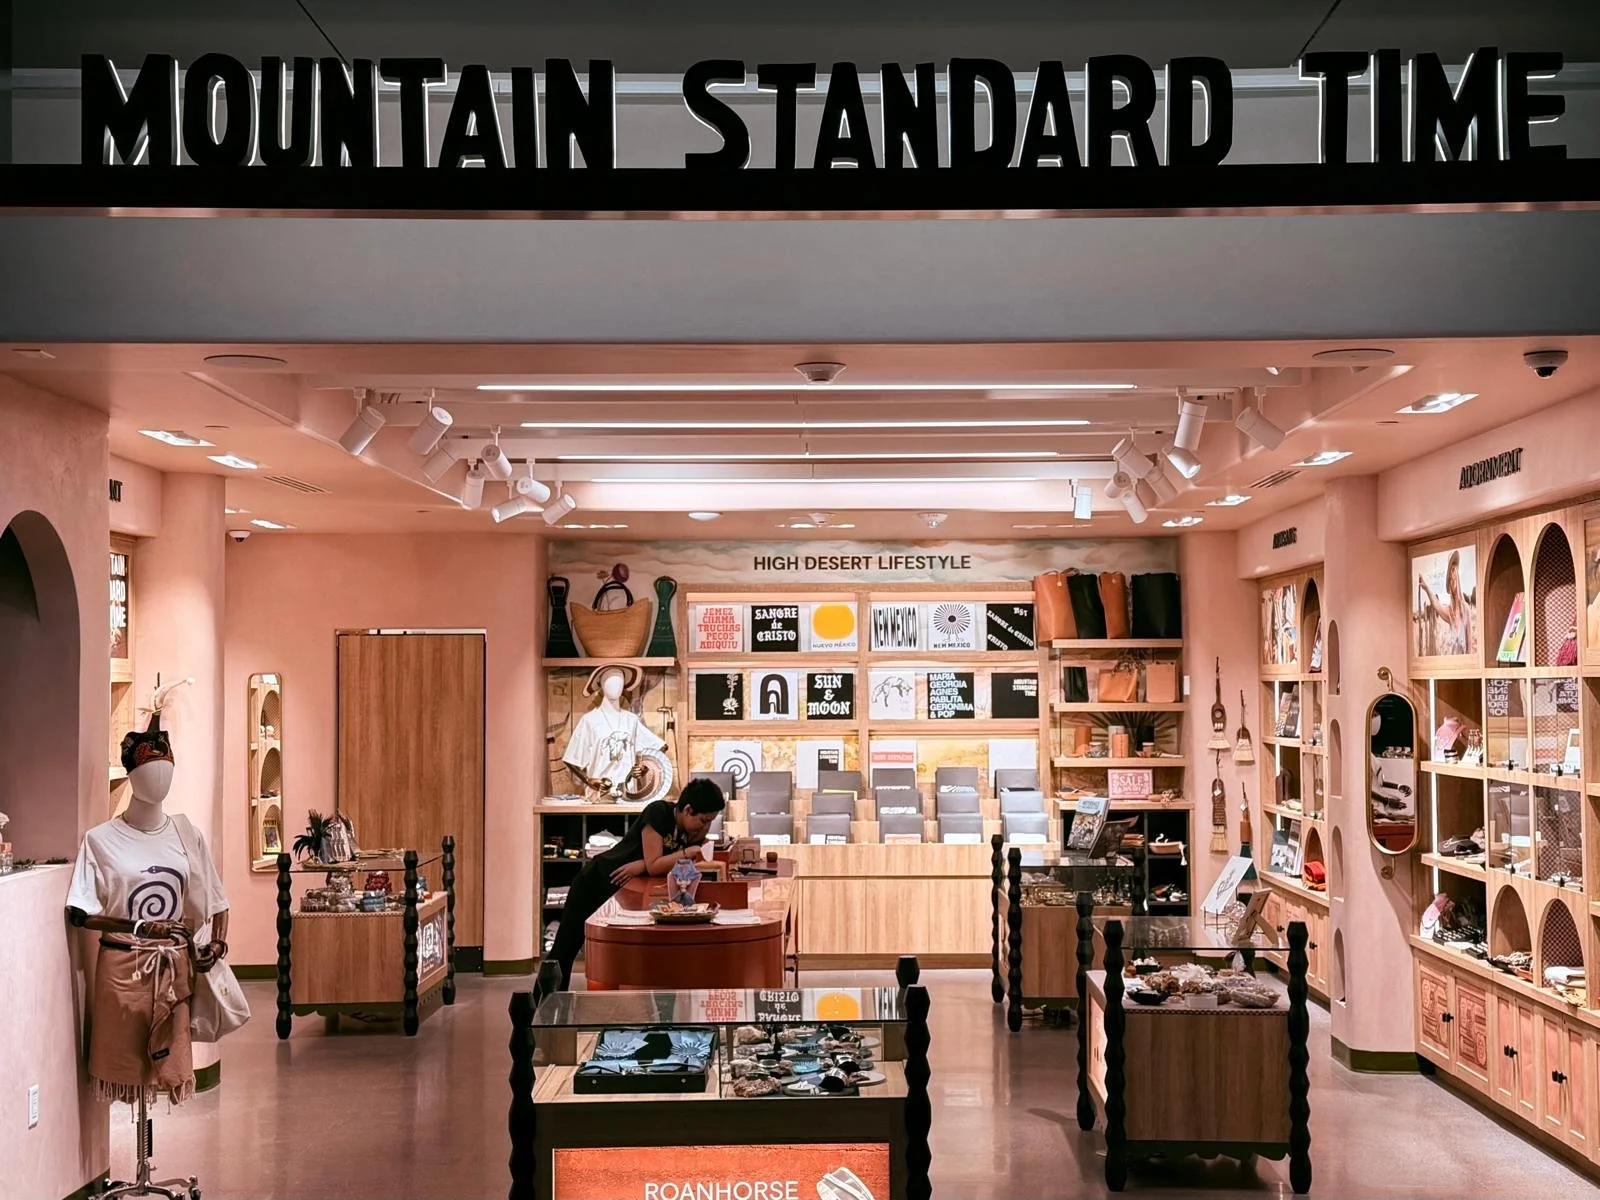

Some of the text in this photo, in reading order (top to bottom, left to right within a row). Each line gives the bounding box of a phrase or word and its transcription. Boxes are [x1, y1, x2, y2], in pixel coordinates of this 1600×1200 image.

[81, 47, 1567, 168] MOUNTAIN STANDARD TIME
[1459, 448, 1523, 490] ADORNMENT
[754, 555, 971, 570] HIGH DESERT LIFESTYLE
[703, 608, 734, 616] JEMEZ
[755, 607, 798, 620] SANGRE
[703, 616, 735, 624] CHAMA
[771, 619, 783, 630] de
[698, 624, 741, 632] TRUCHAS
[873, 606, 918, 649] NEW MEXICO
[706, 632, 735, 640] PECOS
[756, 630, 796, 642] CRISTO
[700, 641, 738, 649] ABIQUIU
[814, 675, 843, 689] SUN
[930, 673, 956, 681] MARIA
[930, 680, 967, 689] GEORGIA
[823, 689, 836, 700] &
[930, 688, 959, 696] AGNES
[930, 695, 963, 704] PABLITA
[807, 701, 850, 716] MOON
[930, 703, 974, 711] GERONIMA
[930, 711, 955, 719] & POP
[1119, 775, 1144, 786] SALE
[645, 1181, 799, 1200] ROANHORSE
